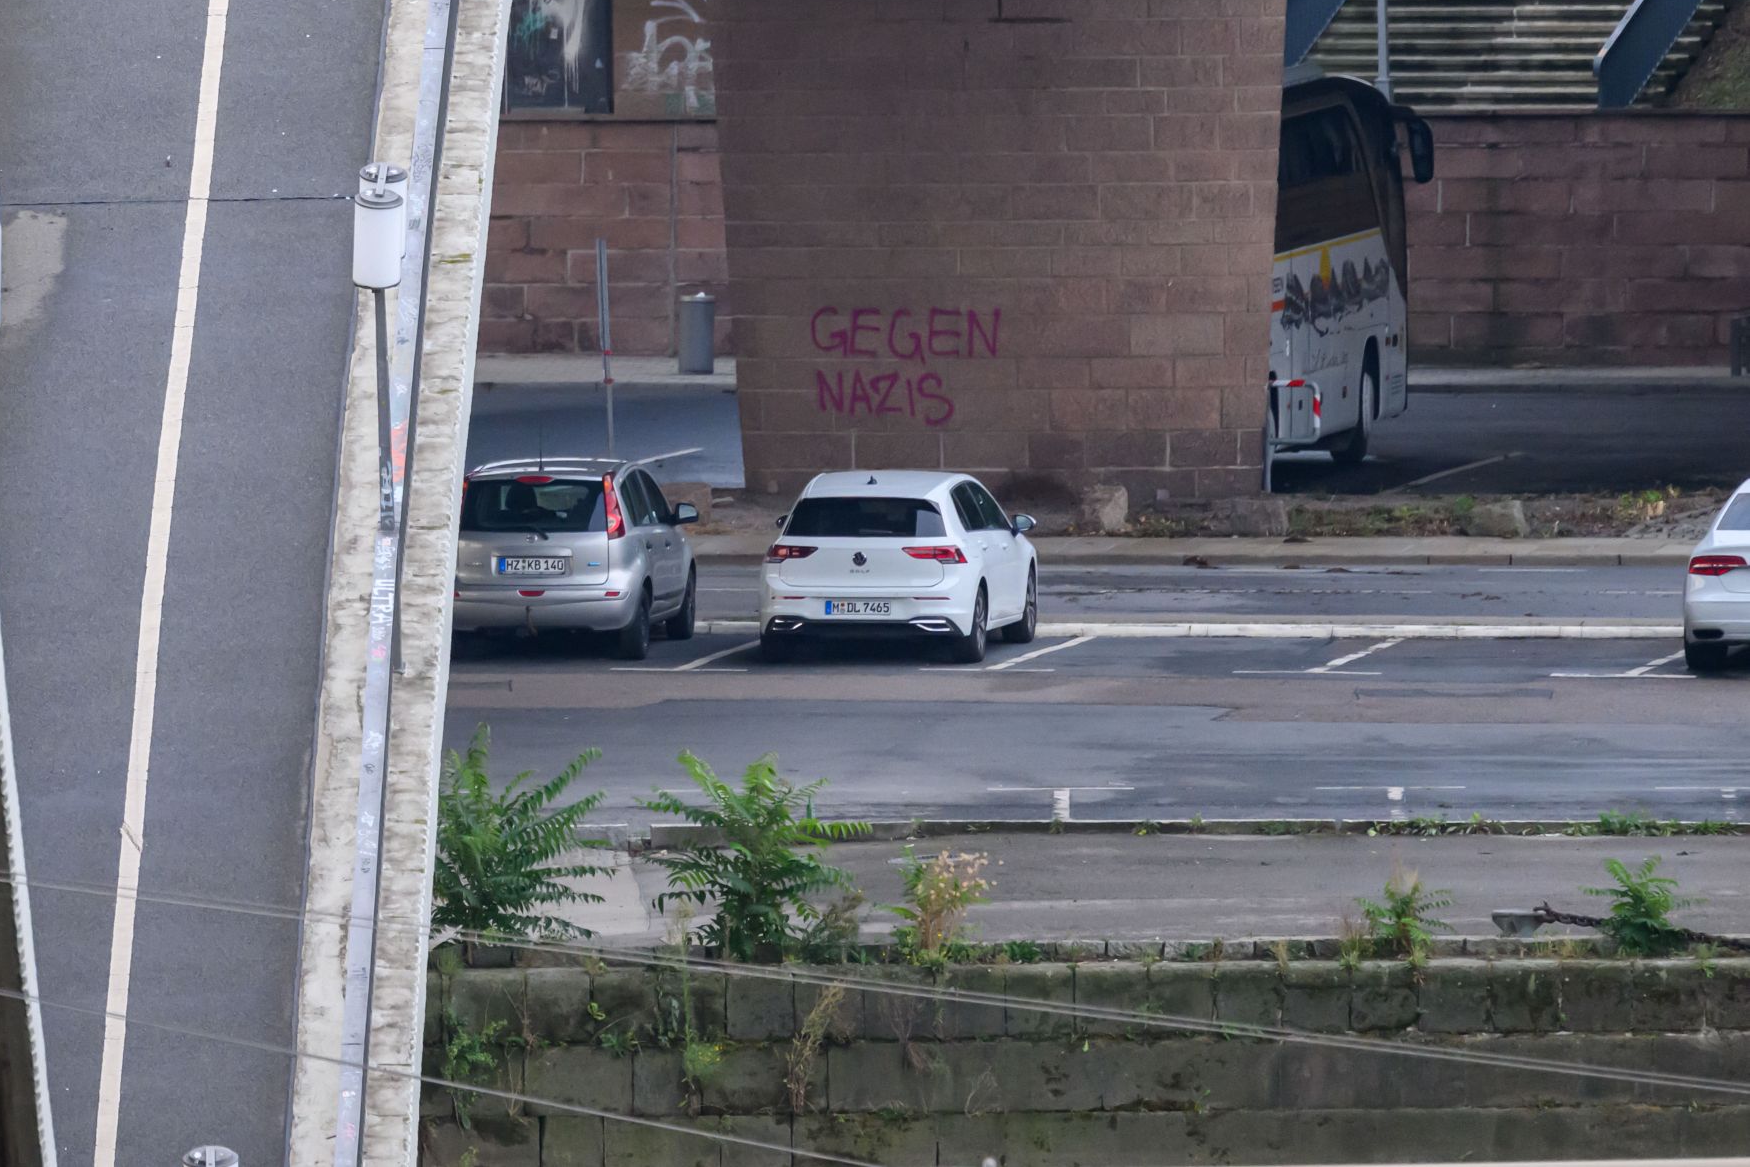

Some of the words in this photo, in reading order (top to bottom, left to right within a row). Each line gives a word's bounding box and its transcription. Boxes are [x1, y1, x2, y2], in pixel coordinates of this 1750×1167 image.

[810, 306, 1002, 365] GEGEN
[816, 369, 955, 426] NAZIS
[863, 602, 890, 613] 7465
